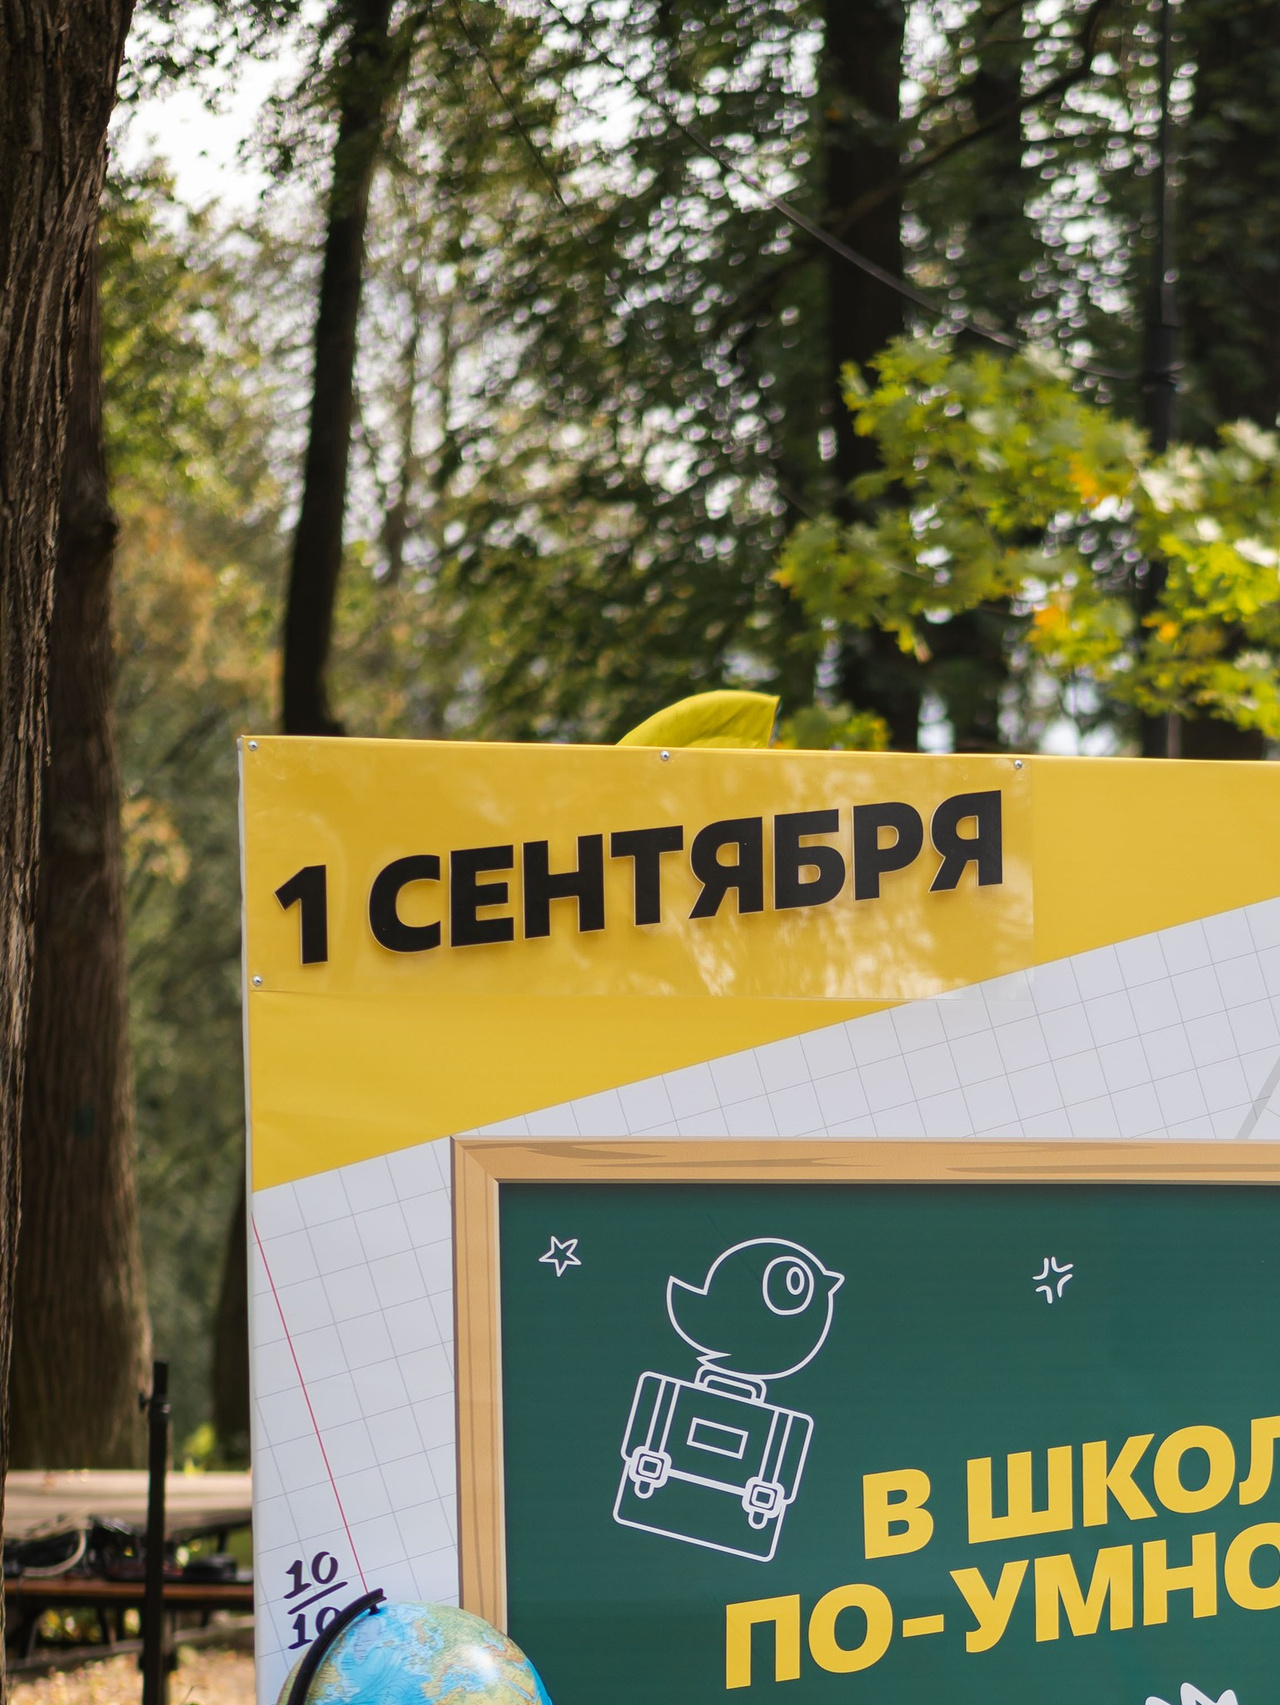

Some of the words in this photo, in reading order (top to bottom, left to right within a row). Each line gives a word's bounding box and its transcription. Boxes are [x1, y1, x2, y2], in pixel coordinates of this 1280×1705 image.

[273, 864, 329, 966] 1
[368, 789, 1003, 954] СЕНТЯБРЯ
[862, 1467, 934, 1560] В
[283, 1551, 339, 1599] 10
